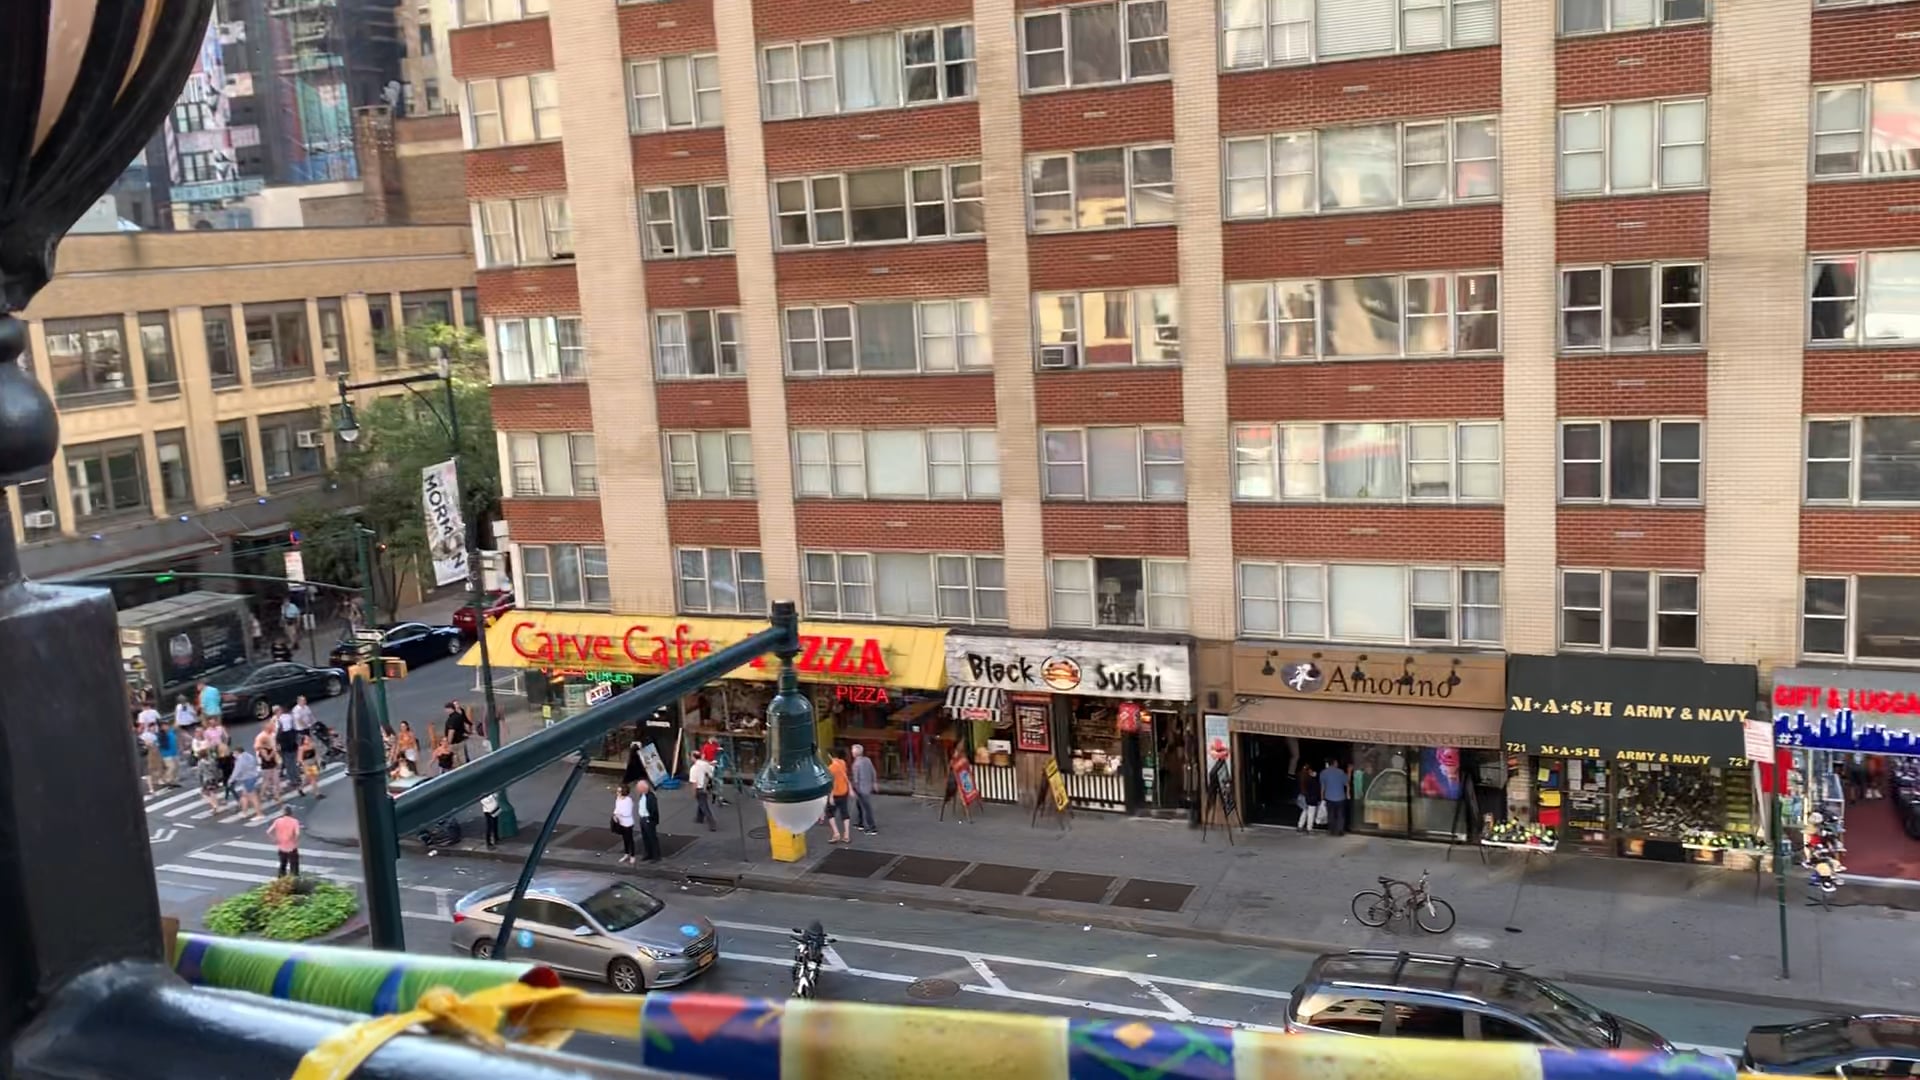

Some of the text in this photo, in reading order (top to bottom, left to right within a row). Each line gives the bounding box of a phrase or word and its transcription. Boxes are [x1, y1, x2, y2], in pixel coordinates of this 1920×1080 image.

[511, 622, 890, 676] Carve Cafe ZZA
[968, 653, 1162, 694] Black Sushi
[1324, 666, 1452, 698] Amorino
[590, 686, 610, 700] ATM
[836, 685, 889, 704] PIZZA
[1774, 684, 1821, 709] GIFT
[1623, 704, 1676, 719] ARMY
[1680, 707, 1693, 721] &
[1698, 708, 1749, 723] NAVY
[1506, 742, 1526, 753] 721
[1616, 750, 1656, 762] ARMY
[1659, 753, 1669, 763] &
[1672, 754, 1711, 765] NAVY
